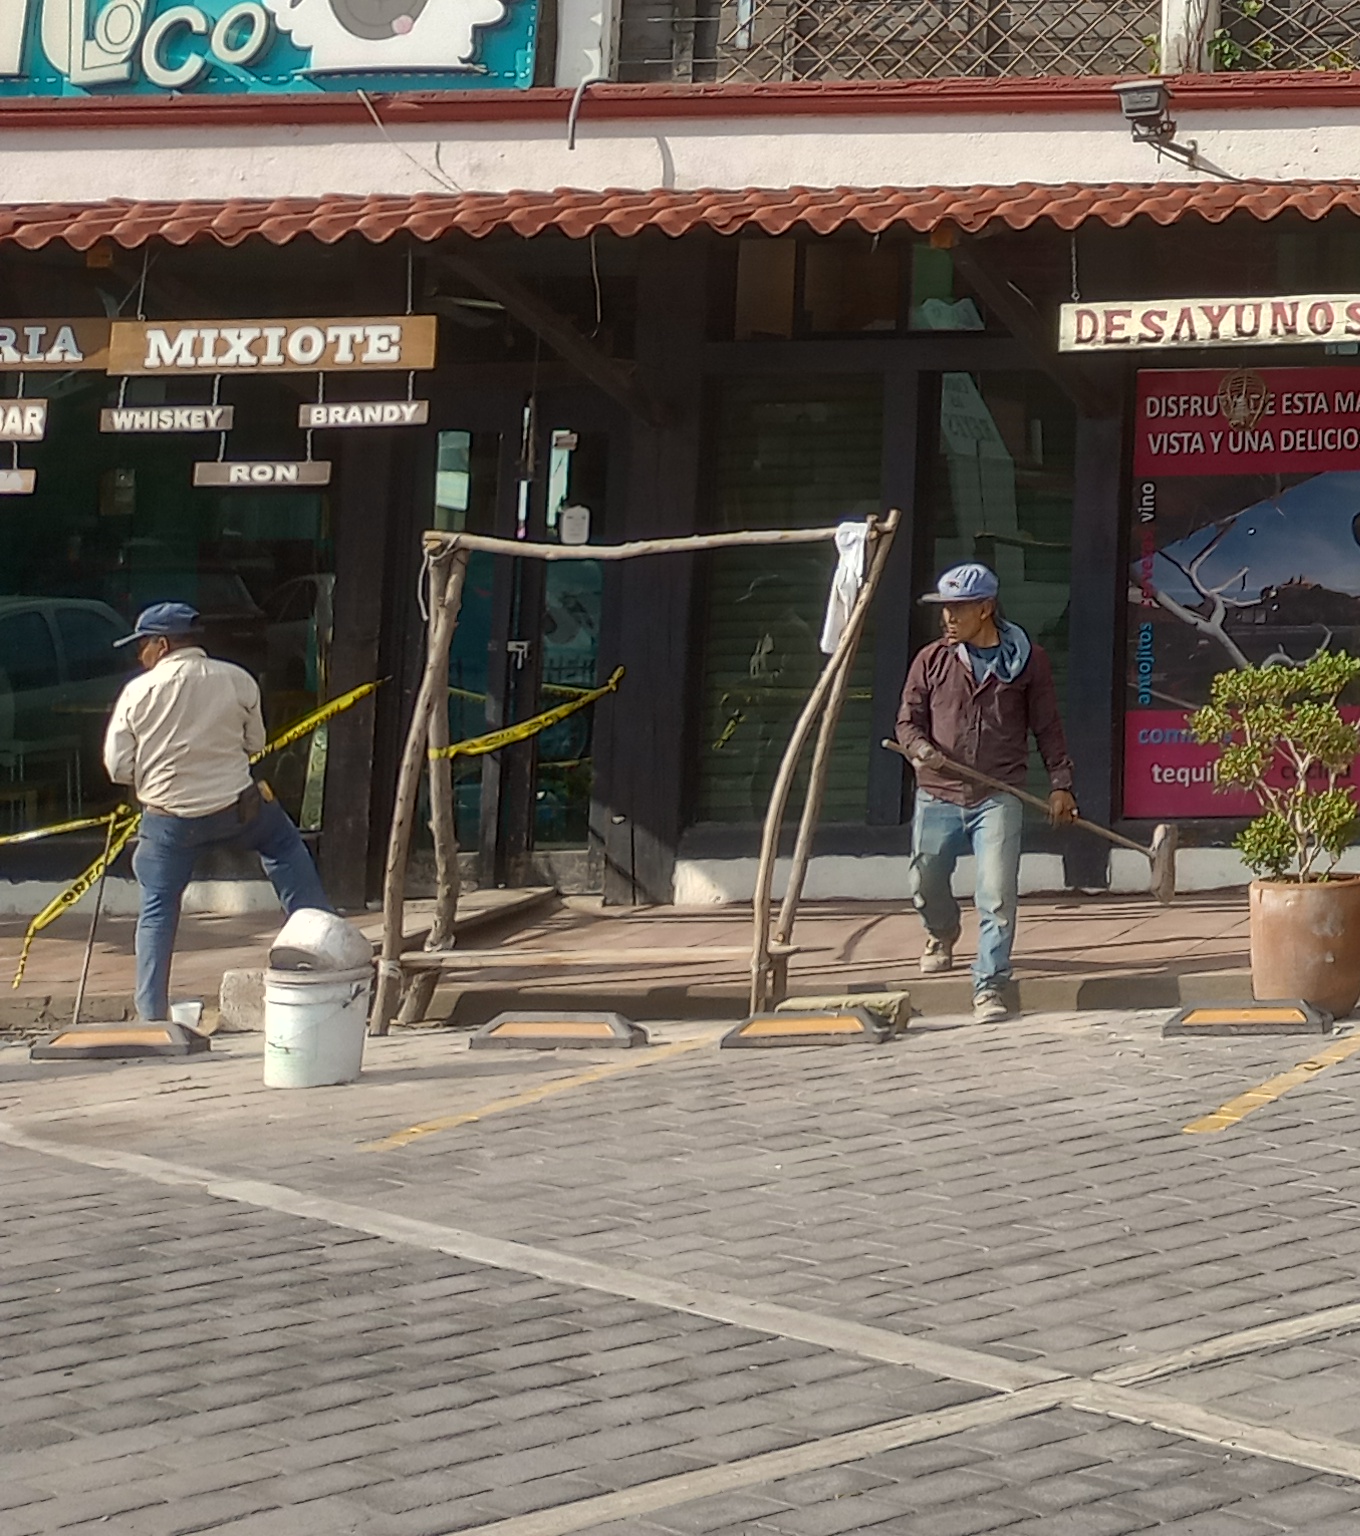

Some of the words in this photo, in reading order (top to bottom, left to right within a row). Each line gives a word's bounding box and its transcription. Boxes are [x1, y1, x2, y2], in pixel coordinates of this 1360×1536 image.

[144, 324, 402, 368] MIXIOTE
[309, 402, 420, 426] BRANDY
[1145, 395, 1222, 419] DISFRU
[1281, 391, 1329, 415] ESTA
[0, 405, 44, 436] AR
[112, 407, 224, 431] WHISKEY
[1147, 432, 1205, 455] VISTA
[1209, 431, 1225, 454] Y
[1227, 429, 1275, 453] UNA
[229, 464, 299, 484] RON
[1138, 481, 1156, 523] vino
[1136, 622, 1154, 705] antojitos
[1151, 762, 1218, 785] tequil
